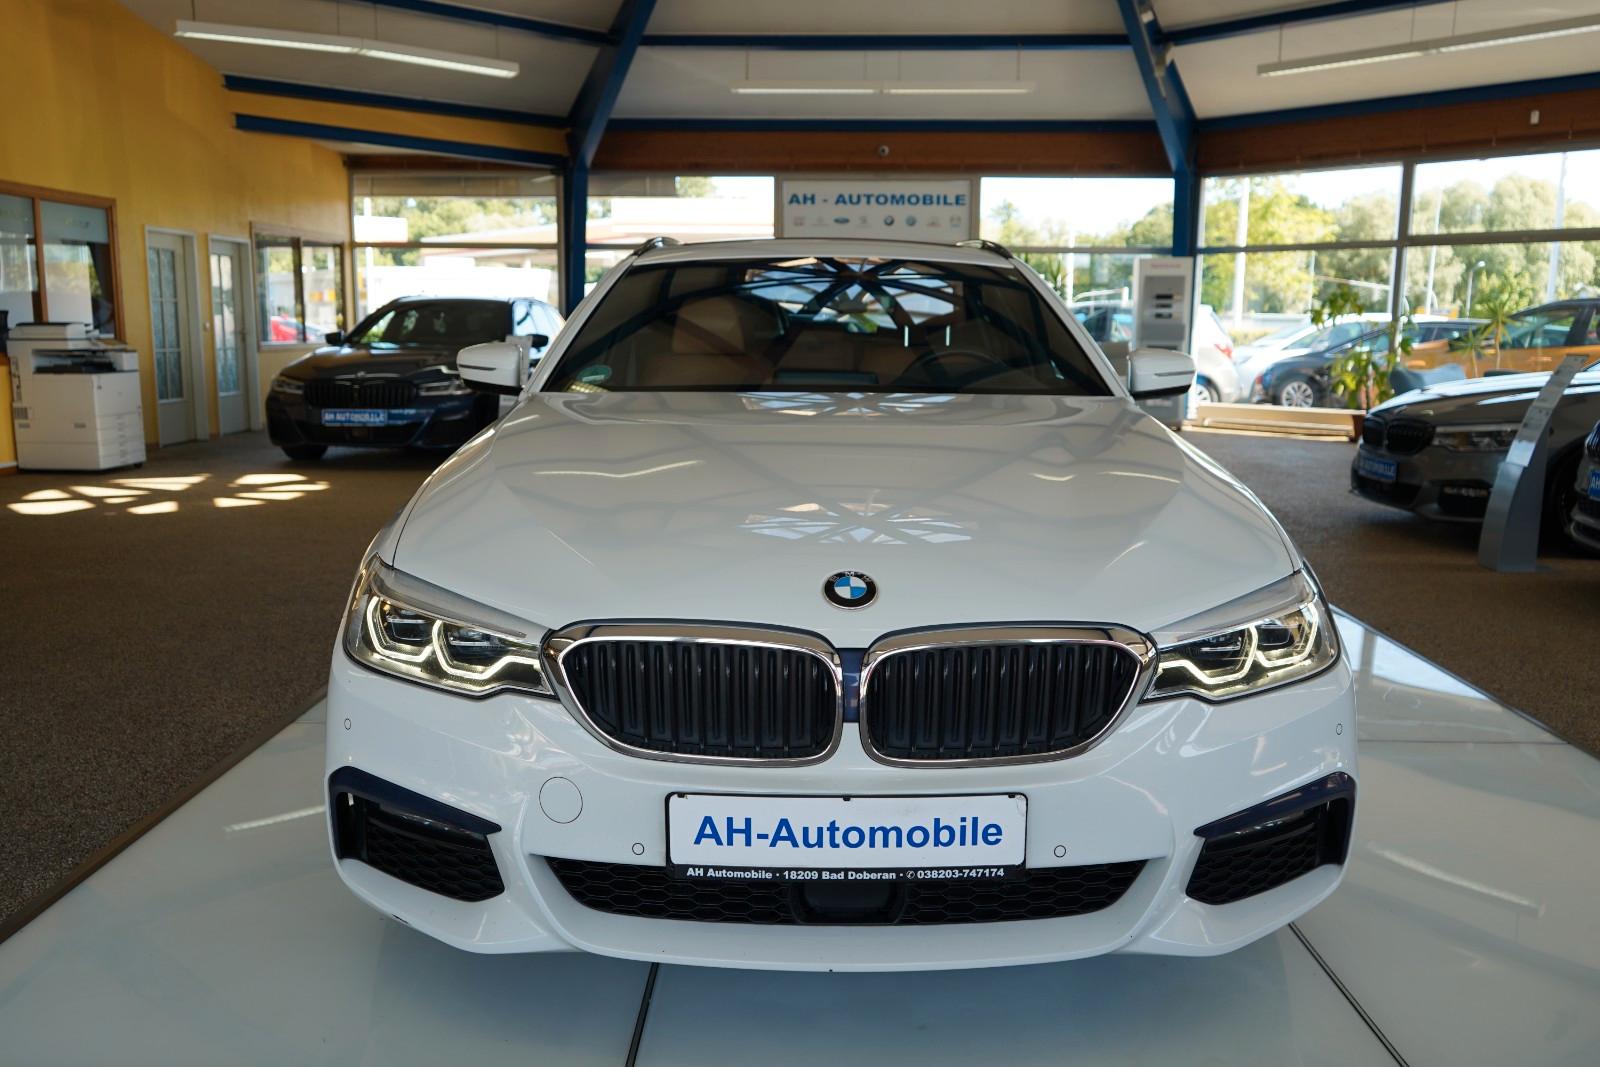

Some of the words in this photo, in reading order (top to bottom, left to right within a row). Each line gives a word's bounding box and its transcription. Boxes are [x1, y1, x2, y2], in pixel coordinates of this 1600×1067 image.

[788, 193, 816, 206] AH
[834, 193, 967, 206] AUTOMOBILE
[693, 815, 1003, 849] AH-Automobile
[686, 867, 704, 877] AH
[706, 868, 773, 879] Automobile
[783, 870, 818, 880] 18209
[821, 871, 845, 880] Bad
[847, 870, 897, 880] Doberan
[916, 868, 1005, 879] 038203-747174
